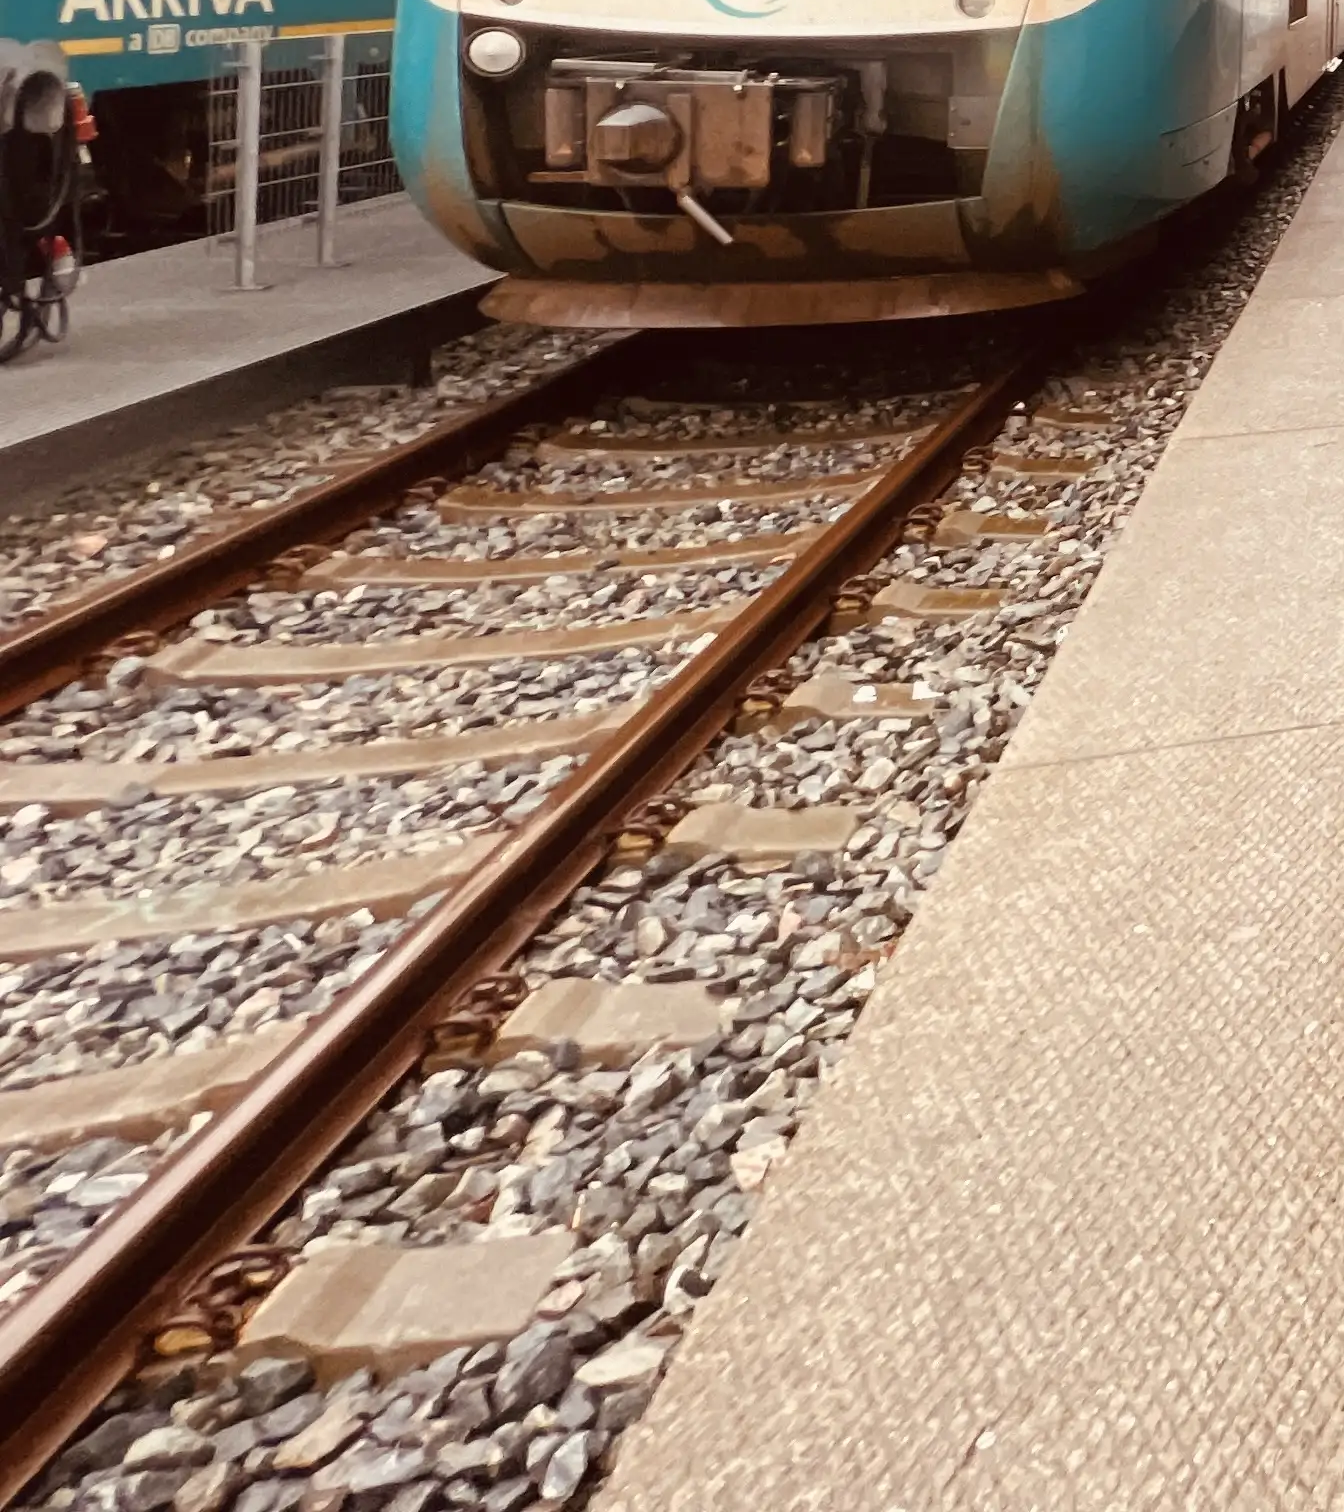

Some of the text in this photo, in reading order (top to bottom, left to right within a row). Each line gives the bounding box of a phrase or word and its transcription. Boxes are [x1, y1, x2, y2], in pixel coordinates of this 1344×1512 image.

[127, 25, 274, 52] a DB company
